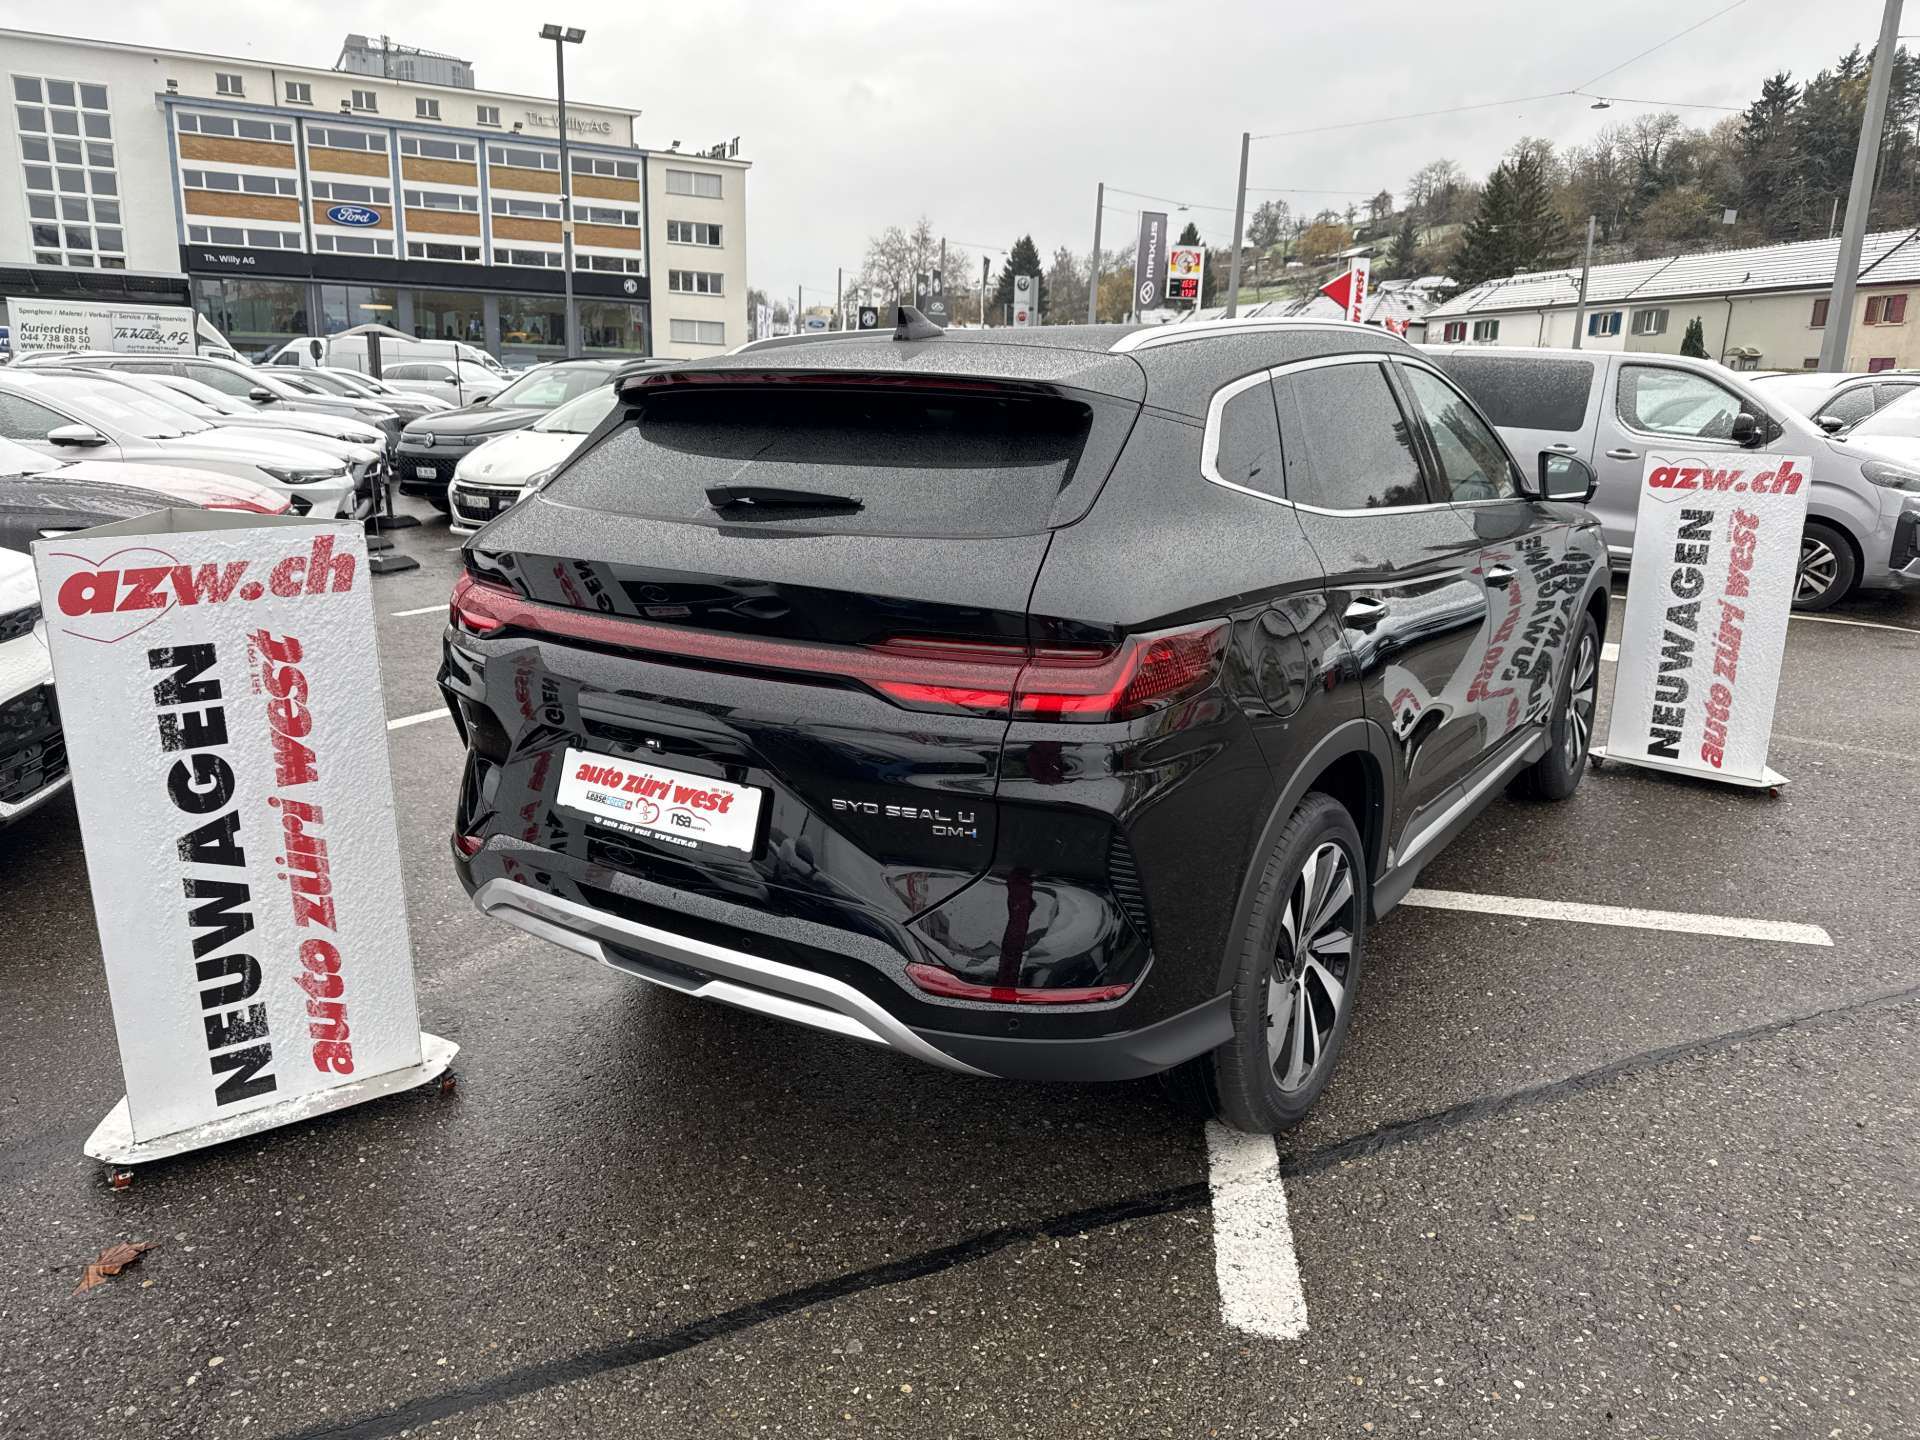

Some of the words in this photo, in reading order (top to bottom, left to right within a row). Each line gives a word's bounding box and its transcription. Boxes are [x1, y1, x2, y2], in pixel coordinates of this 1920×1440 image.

[591, 119, 613, 134] AG
[338, 206, 370, 223] Ford
[203, 253, 218, 262] Th.
[219, 254, 241, 265] Willy
[242, 256, 256, 265] AG
[20, 322, 89, 336] Kurierdienst
[20, 332, 40, 341] 044
[42, 333, 60, 343] 738
[63, 334, 75, 344] 88
[78, 335, 91, 344] 50
[1648, 460, 1803, 495] azw.ch
[57, 534, 354, 617] azw.ch
[1725, 507, 1760, 597] west
[1647, 508, 1715, 760] NEUWAGEN
[1711, 598, 1746, 685] züri
[246, 628, 313, 788] west
[1701, 683, 1733, 769] auto
[575, 763, 624, 789] auto
[621, 773, 674, 800] züri
[672, 785, 735, 814] west
[831, 798, 879, 814] BYD
[885, 805, 952, 822] SEAL
[957, 811, 975, 823] U
[602, 818, 619, 829] auto
[634, 827, 652, 838] west
[670, 812, 692, 829] nsa
[147, 642, 279, 1106] NEUWAGEN
[267, 796, 339, 933] züri
[292, 938, 355, 1075] auto
